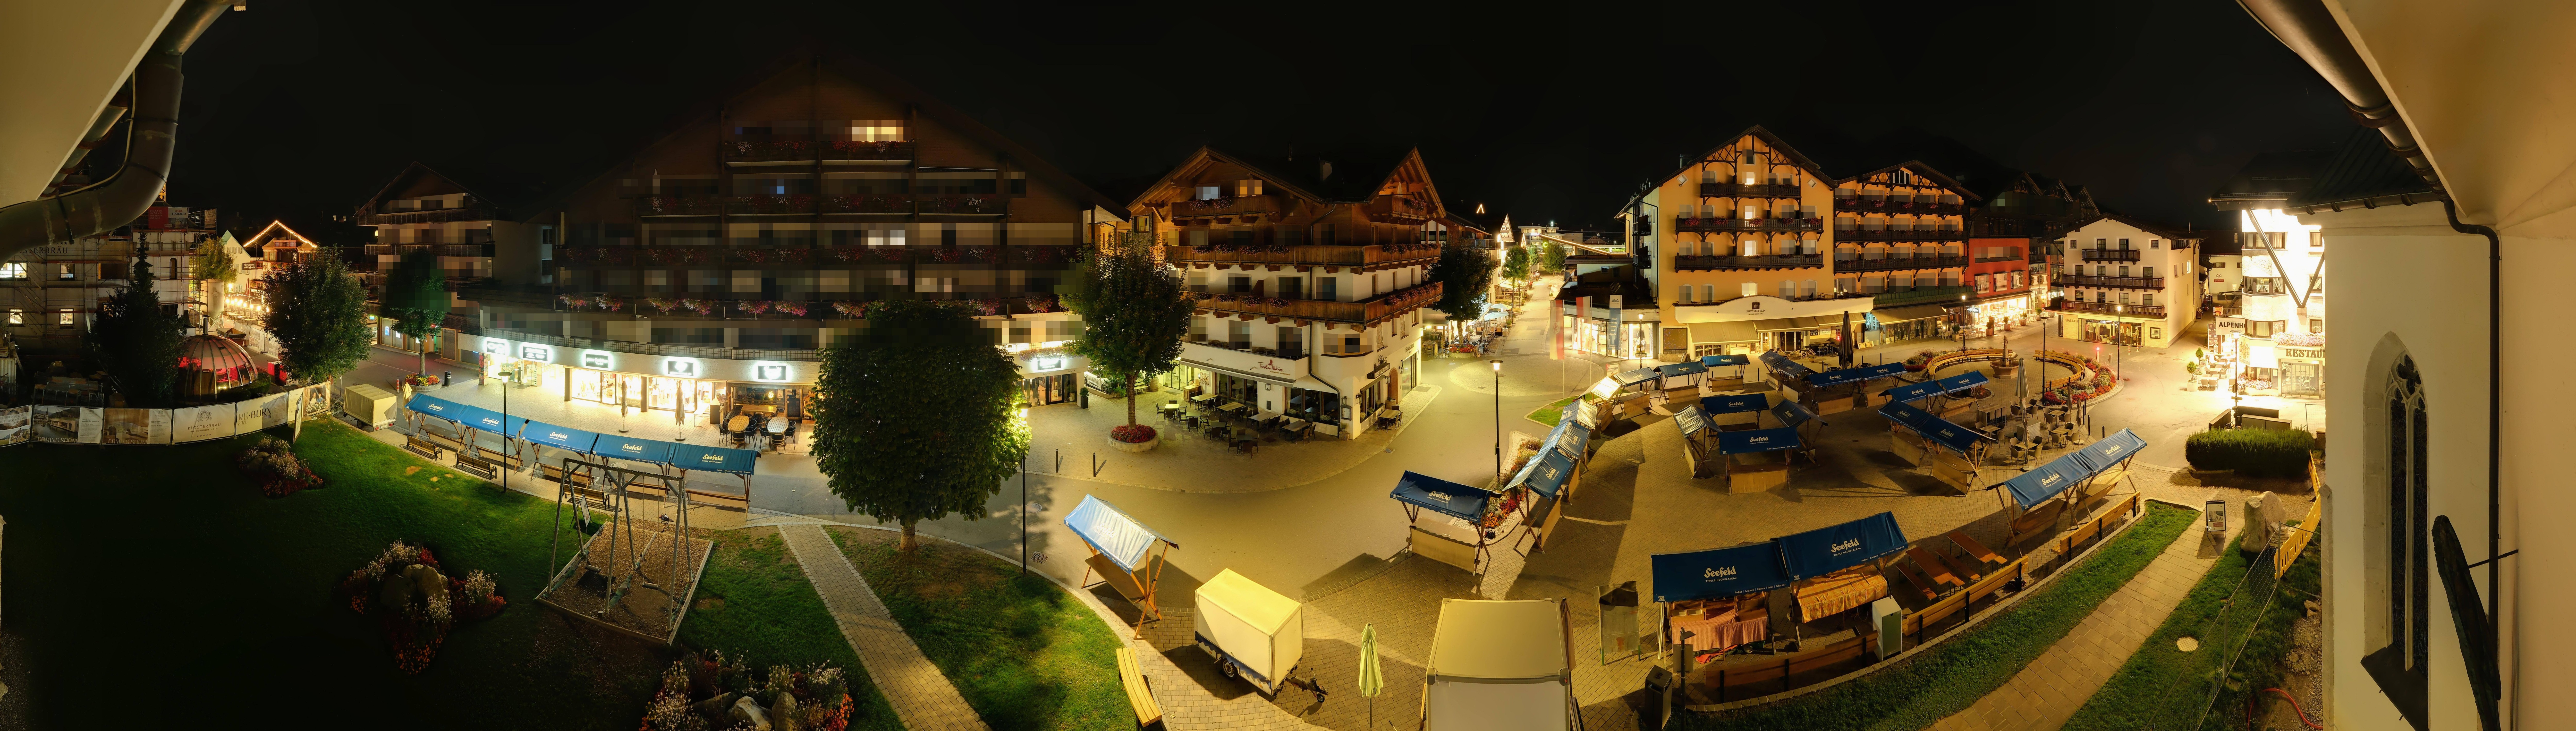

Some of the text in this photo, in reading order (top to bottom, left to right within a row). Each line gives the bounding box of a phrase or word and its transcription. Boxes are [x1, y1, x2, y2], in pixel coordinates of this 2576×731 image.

[1405, 343, 1414, 352] SAILER
[1375, 364, 1389, 378] RESTAURANT
[1940, 429, 1954, 437] Seefeld
[2105, 445, 2120, 455] Seefeld
[1546, 468, 1556, 479] Seefeld
[2042, 473, 2060, 485] Seefeld
[1429, 490, 1452, 501] Seefeld
[1097, 523, 1117, 538] Seefeld
[1831, 538, 1860, 553] Seefeld
[1704, 566, 1736, 578] Seefeld
